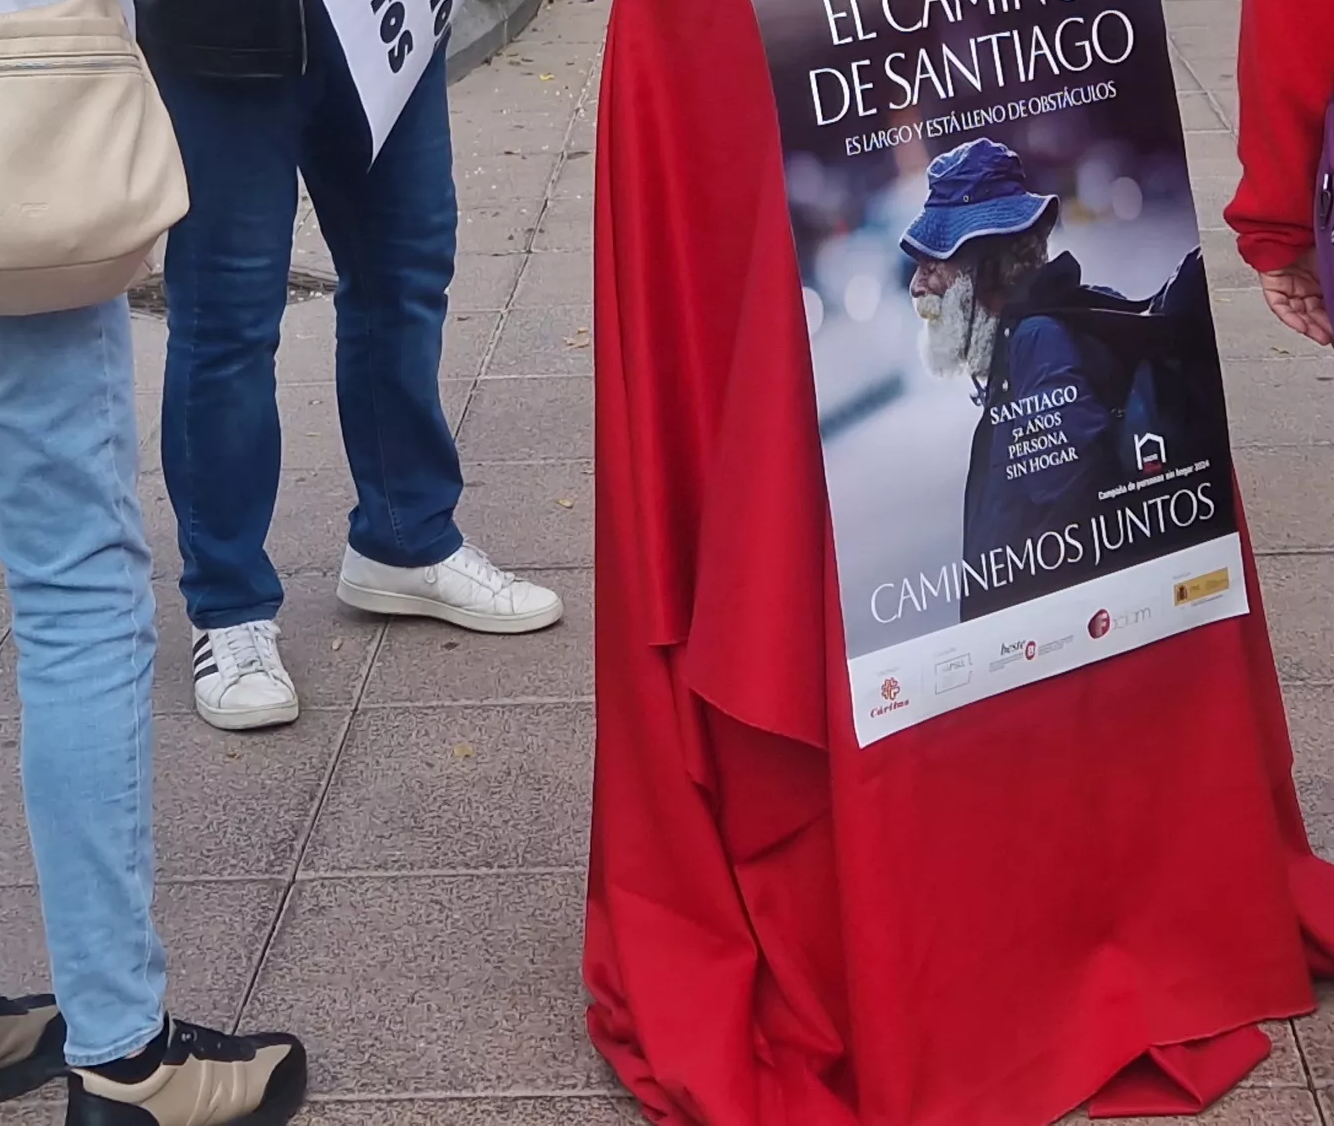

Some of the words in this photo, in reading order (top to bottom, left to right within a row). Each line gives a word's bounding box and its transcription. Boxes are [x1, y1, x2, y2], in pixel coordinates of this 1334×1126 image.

[809, 59, 877, 126] DE
[884, 9, 1134, 110] SANTIAGO
[845, 136, 862, 156] ES
[863, 125, 912, 152] LARGO
[912, 122, 924, 140] Y
[926, 110, 961, 138] ESTÁ
[961, 104, 1006, 131] LLENO
[1008, 100, 1028, 121] DE
[1028, 80, 1118, 115] OBSTÁCULOS
[990, 385, 1078, 425] SANTIAGO
[1025, 411, 1062, 435] AÑOS
[1006, 460, 1028, 480] SIN
[1028, 446, 1079, 473] HOGAR
[1008, 430, 1068, 460] PERSONA
[1127, 481, 1136, 491] de
[870, 523, 1083, 623] CAMINEMOS
[1091, 482, 1215, 566] JUNTOS
